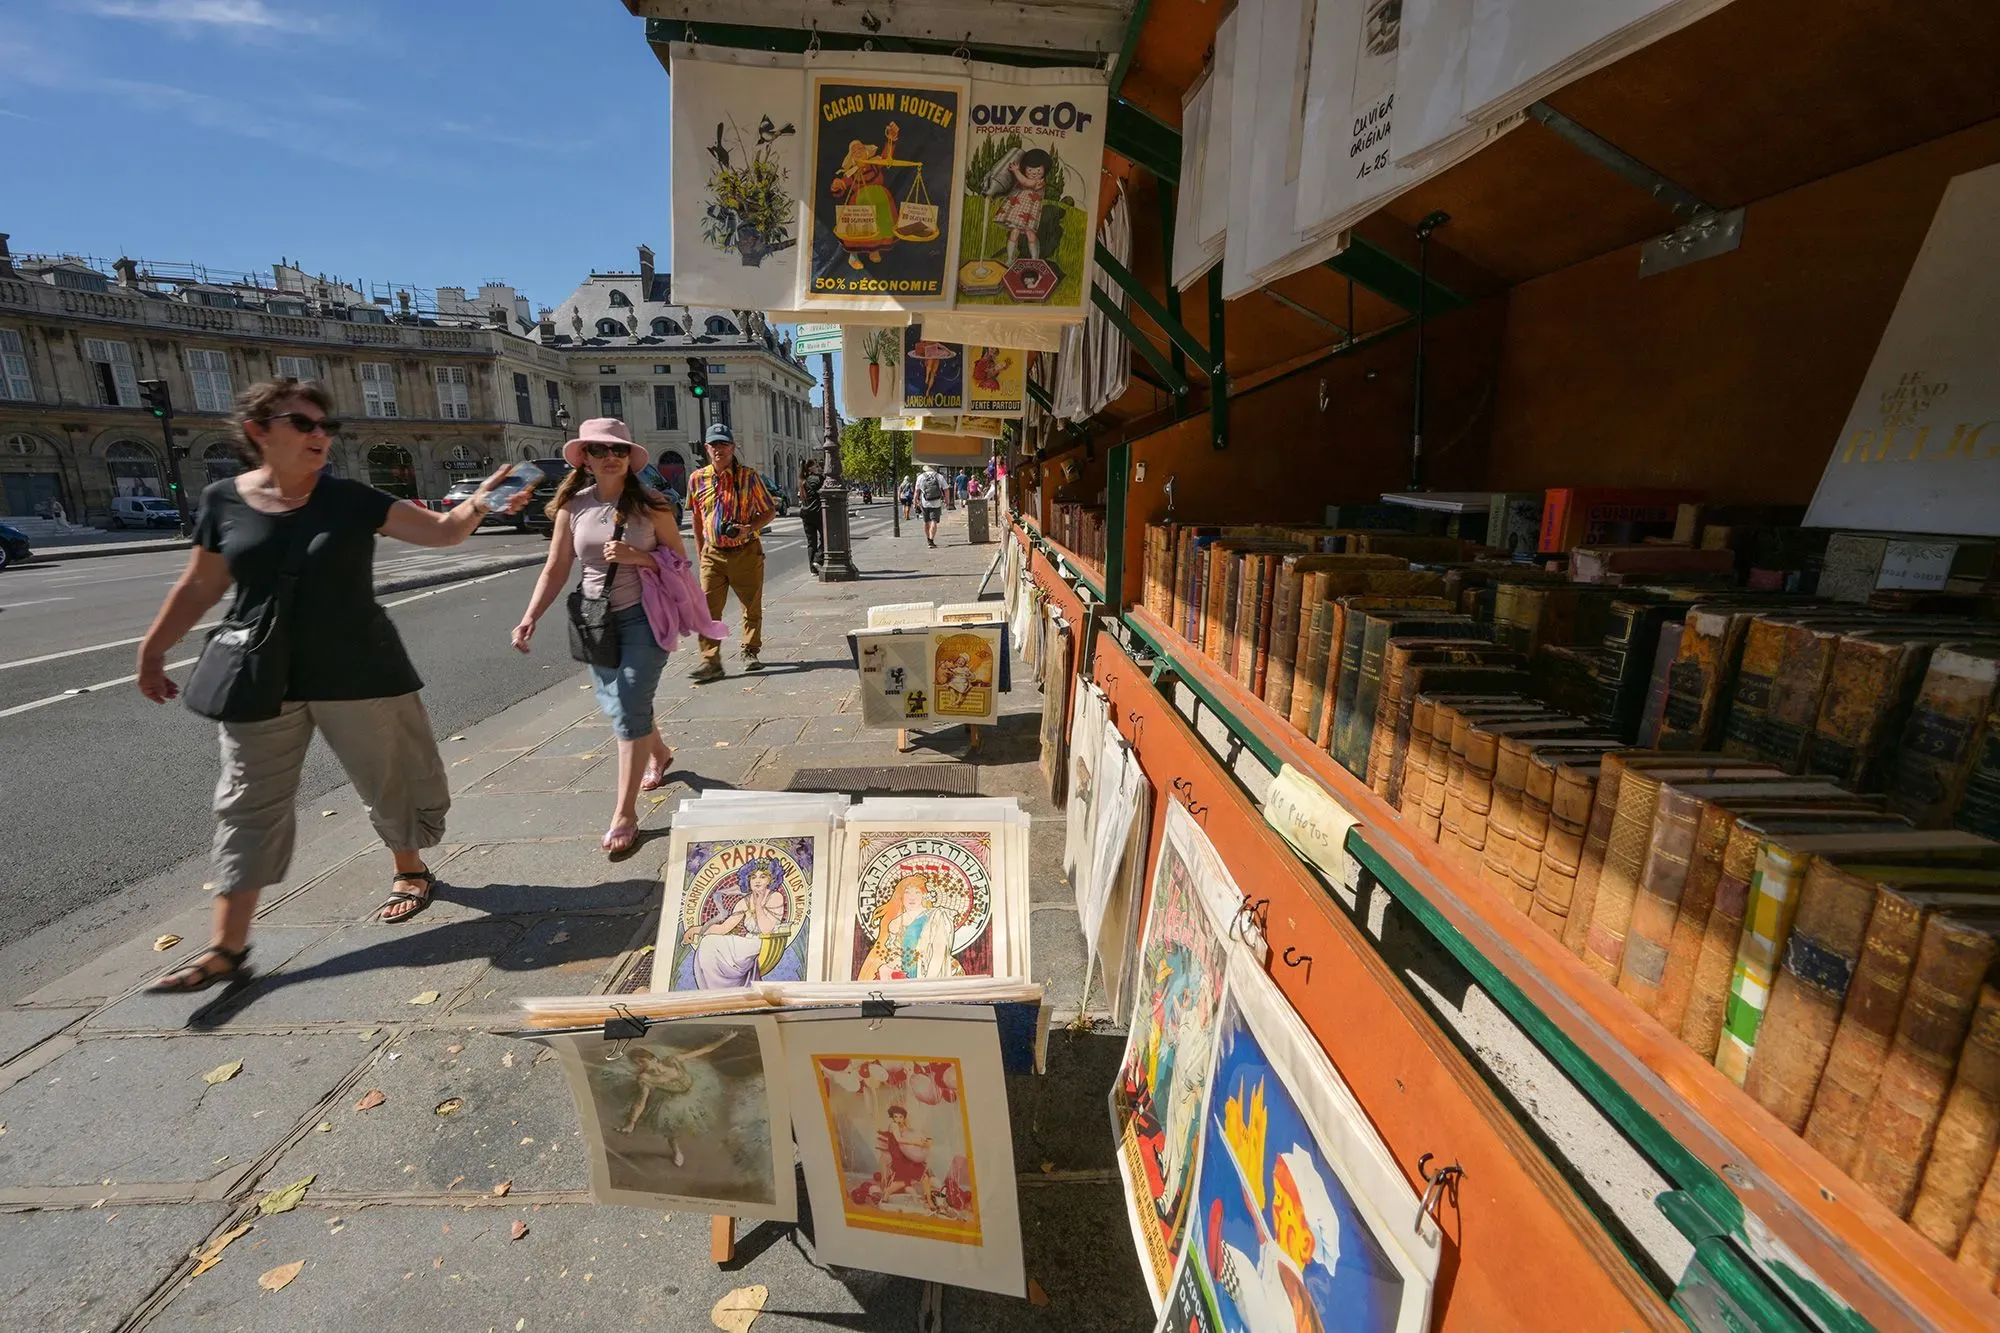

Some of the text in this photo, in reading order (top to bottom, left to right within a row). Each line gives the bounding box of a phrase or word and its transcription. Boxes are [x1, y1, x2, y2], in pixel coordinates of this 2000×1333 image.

[823, 93, 953, 129] CACAO VAN HOUTEN
[969, 104, 1028, 126] ouy
[1353, 93, 1394, 136] CUVIER
[976, 125, 1021, 134] FROMAGE
[1023, 126, 1033, 135] DE
[1350, 121, 1391, 158] ORIGINA
[815, 277, 846, 290] 50%
[905, 392, 961, 408] JAMBON OLIDA
[971, 400, 1021, 412] VENTE PARTOUT
[1287, 803, 1329, 848] PHOTOS
[720, 845, 776, 870] PARIS
[788, 874, 804, 893] LOS
[793, 894, 806, 926] MEJORES
[1145, 1201, 1156, 1225] NOIX
[1152, 1226, 1160, 1239] DE
[1155, 1238, 1168, 1269] COCO
[1180, 1283, 1191, 1319] DE
